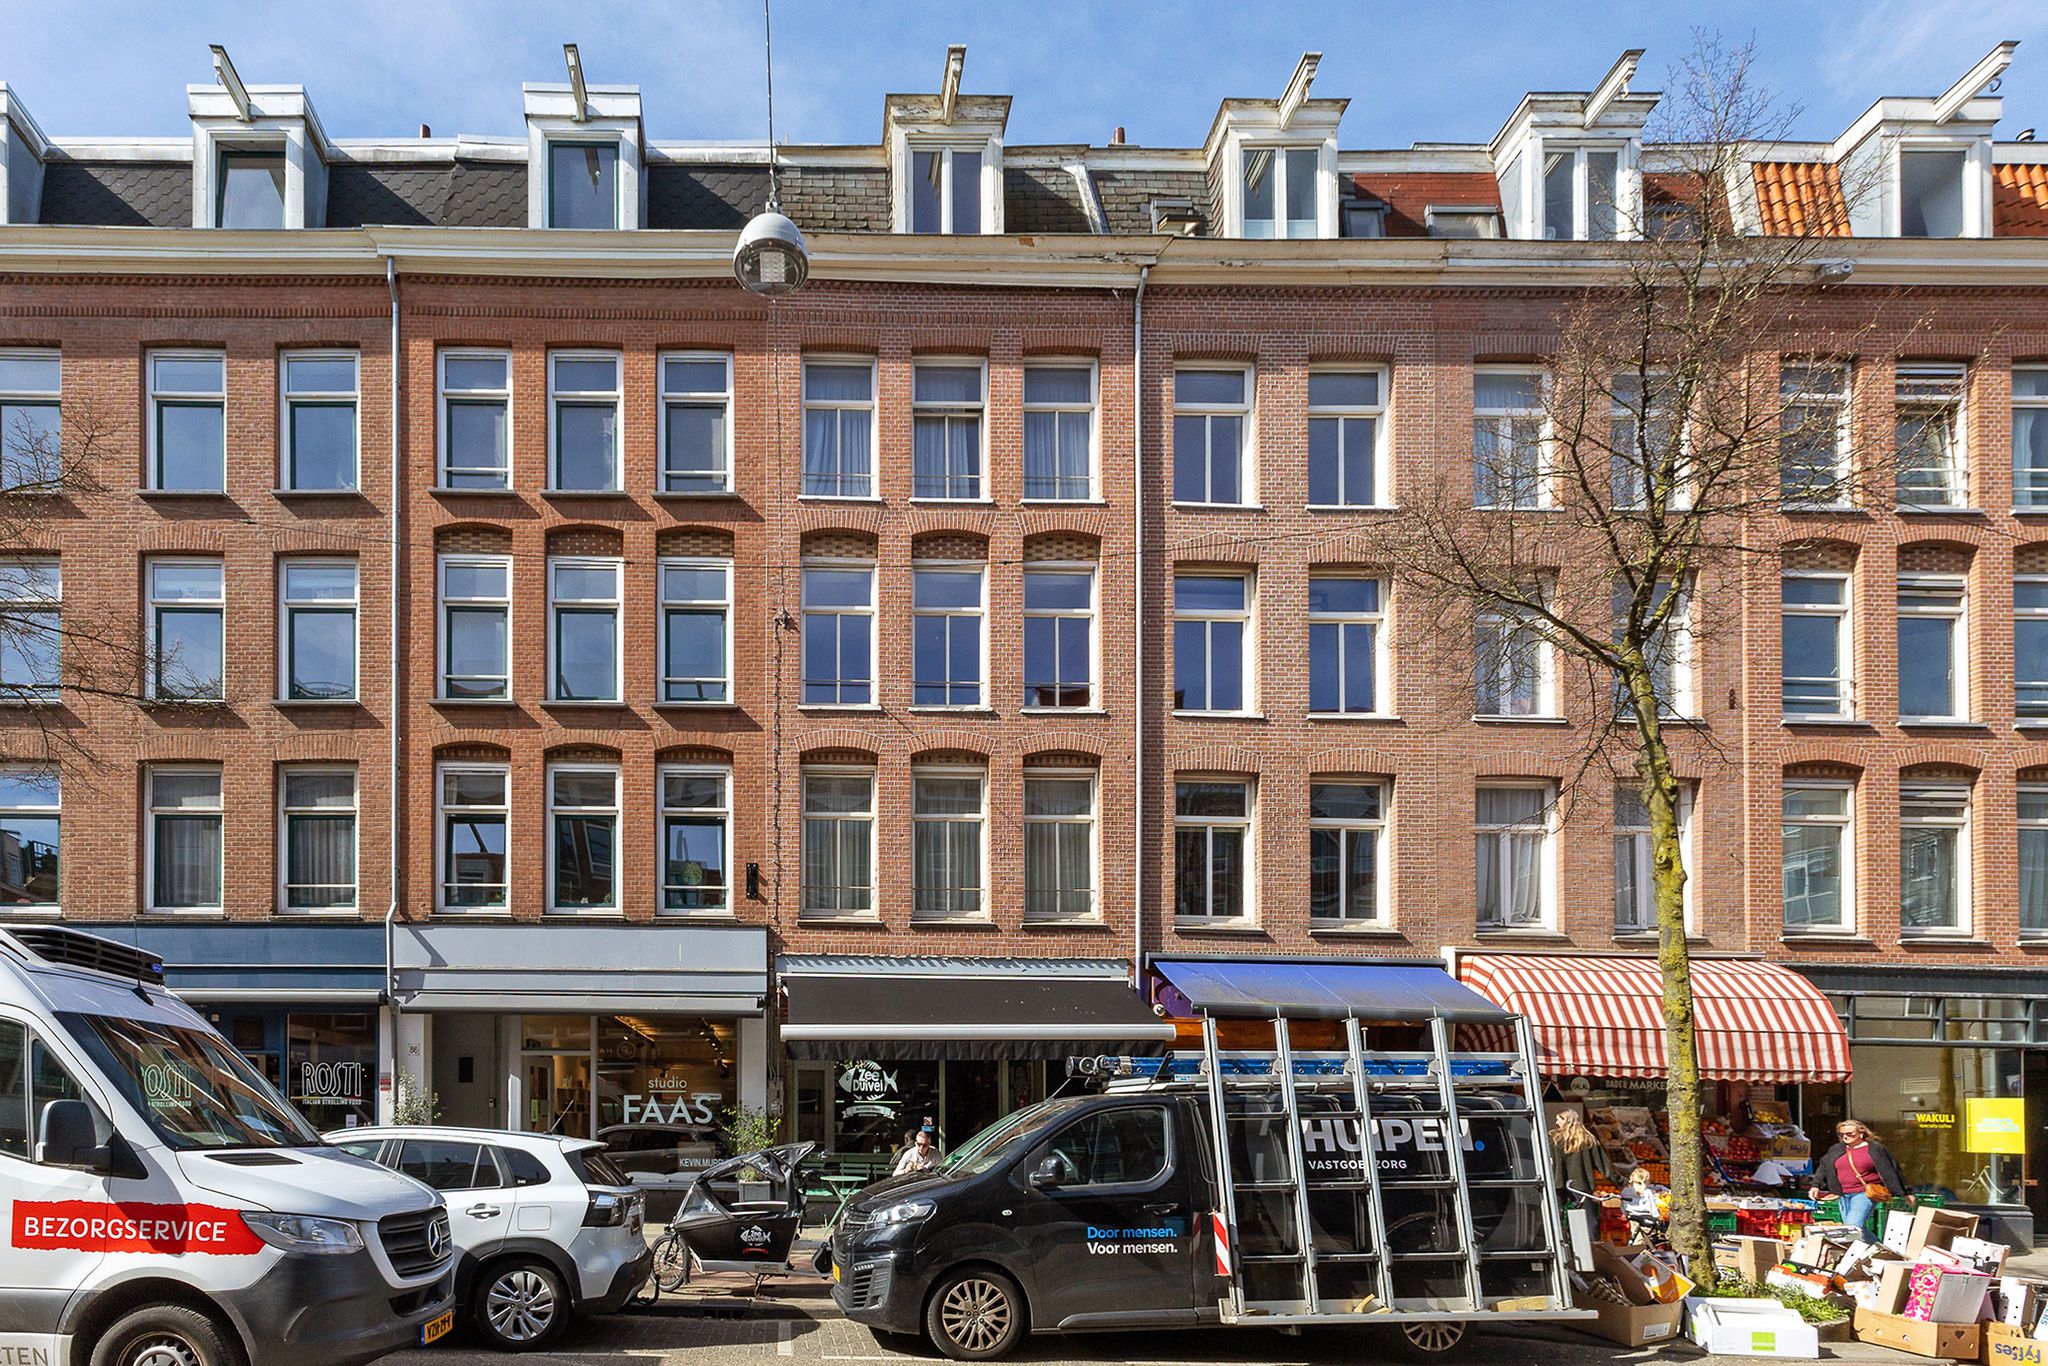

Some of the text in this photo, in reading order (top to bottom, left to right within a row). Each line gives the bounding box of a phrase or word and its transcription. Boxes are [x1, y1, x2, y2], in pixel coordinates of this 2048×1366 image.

[409, 1045, 418, 1054] 86
[141, 1063, 192, 1099] OSTI
[302, 1061, 362, 1097] ROSTI
[648, 1075, 687, 1089] studio
[858, 1068, 881, 1082] Zee
[1630, 1080, 1667, 1090] MARKE
[623, 1094, 714, 1124] FAAS
[1916, 1113, 1955, 1123] WAKULI
[1308, 1159, 1408, 1170] VASTGOEZORG
[24, 1216, 227, 1242] BEZORGSERVICE
[1087, 1226, 1178, 1239] Door mensen.
[1086, 1242, 1178, 1254] Voor mensen.
[0, 1346, 49, 1366] TEN
